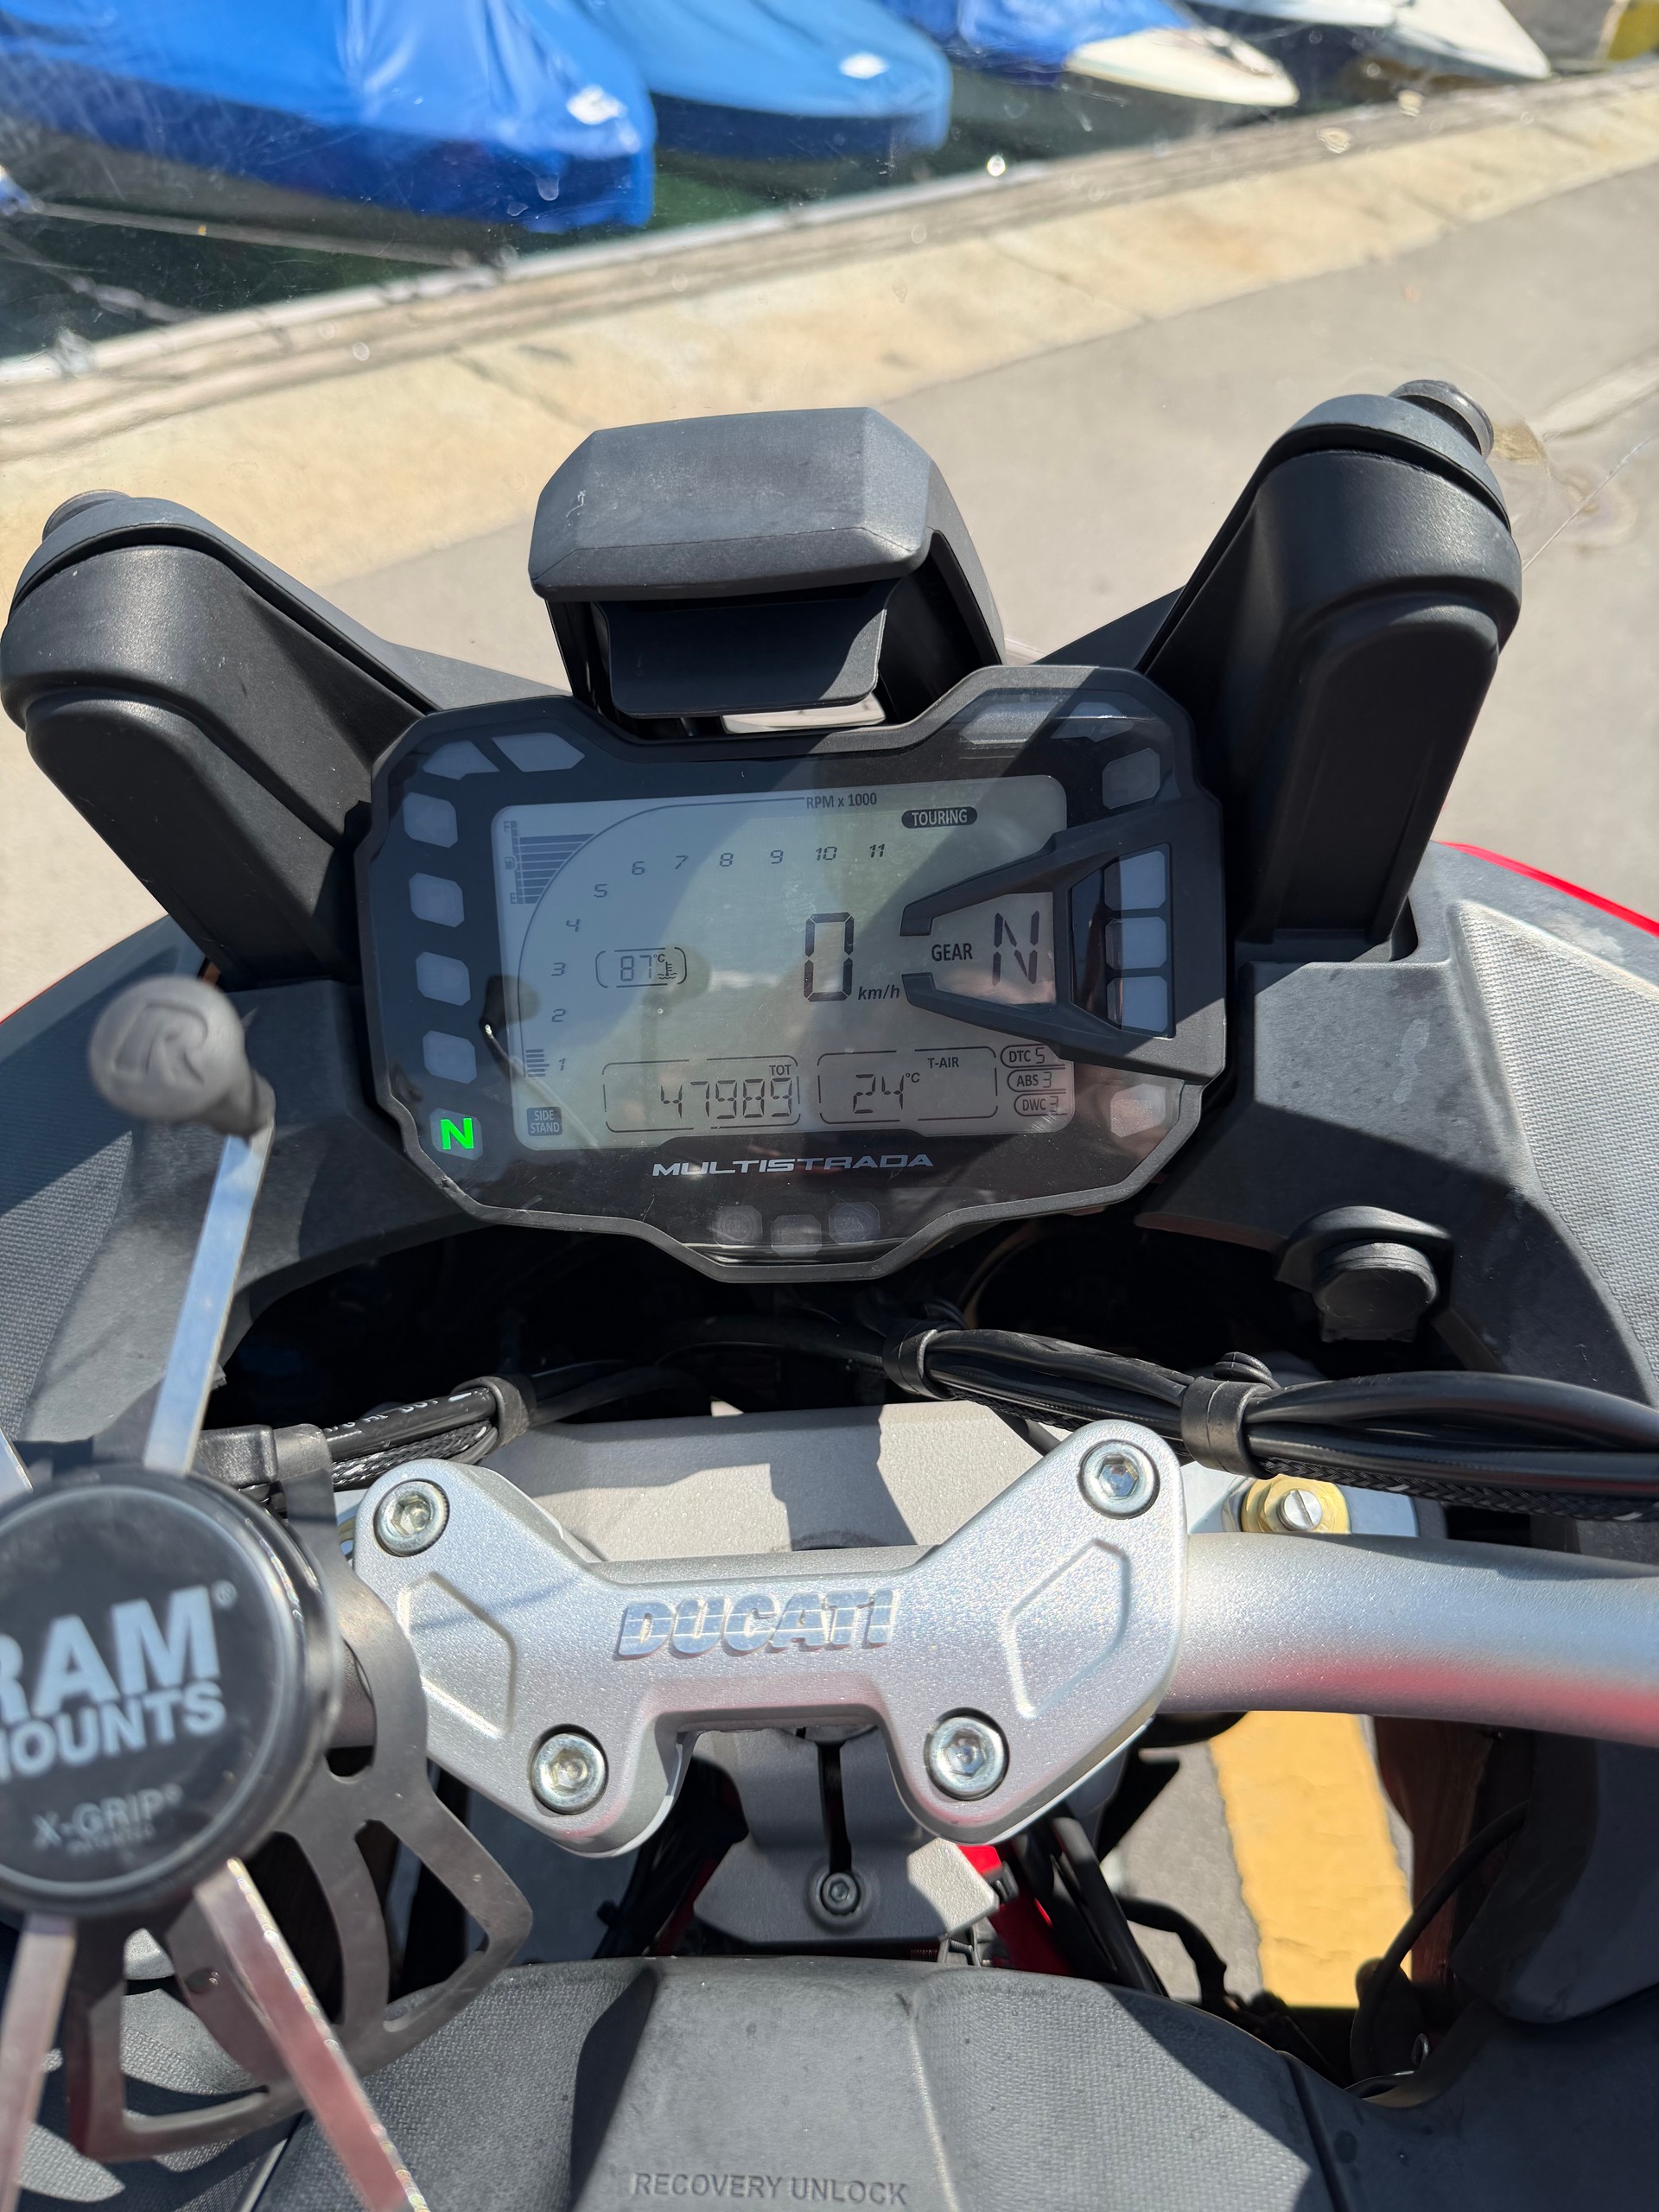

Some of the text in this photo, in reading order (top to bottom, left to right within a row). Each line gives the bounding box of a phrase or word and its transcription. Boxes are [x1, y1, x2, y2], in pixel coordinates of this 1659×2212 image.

[806, 794, 835, 809] RPM
[848, 792, 877, 807] 1000
[912, 808, 968, 826] TOURING
[770, 849, 784, 865] 9
[816, 846, 837, 861] 10
[869, 843, 885, 858] 11
[674, 855, 689, 869] 7
[720, 852, 734, 868] 8
[632, 861, 645, 875] 6
[594, 883, 608, 898] 5
[566, 918, 581, 932] 4
[931, 943, 973, 962] GEAR
[993, 910, 1040, 986] N
[550, 962, 566, 977] 3
[620, 954, 652, 982] 87
[857, 984, 899, 1001] km/h
[551, 1008, 567, 1023] 2
[927, 1056, 960, 1069] T-AIR
[1008, 1050, 1032, 1064] DTC
[558, 1058, 567, 1072] 1
[769, 1064, 792, 1077] TOT
[1016, 1073, 1039, 1087] ABS
[660, 1077, 793, 1120] 47989
[852, 1073, 905, 1115] 24
[1022, 1097, 1046, 1111] DWC
[534, 1109, 555, 1122] SIDE
[440, 1117, 474, 1150] N
[530, 1122, 560, 1134] STAND
[652, 1154, 934, 1177] MULTISTRADA
[614, 1588, 896, 1658] DUCATI
[0, 1680, 226, 1783] OUNTS
[632, 2172, 908, 2206] RECOVERY UNLOCK
